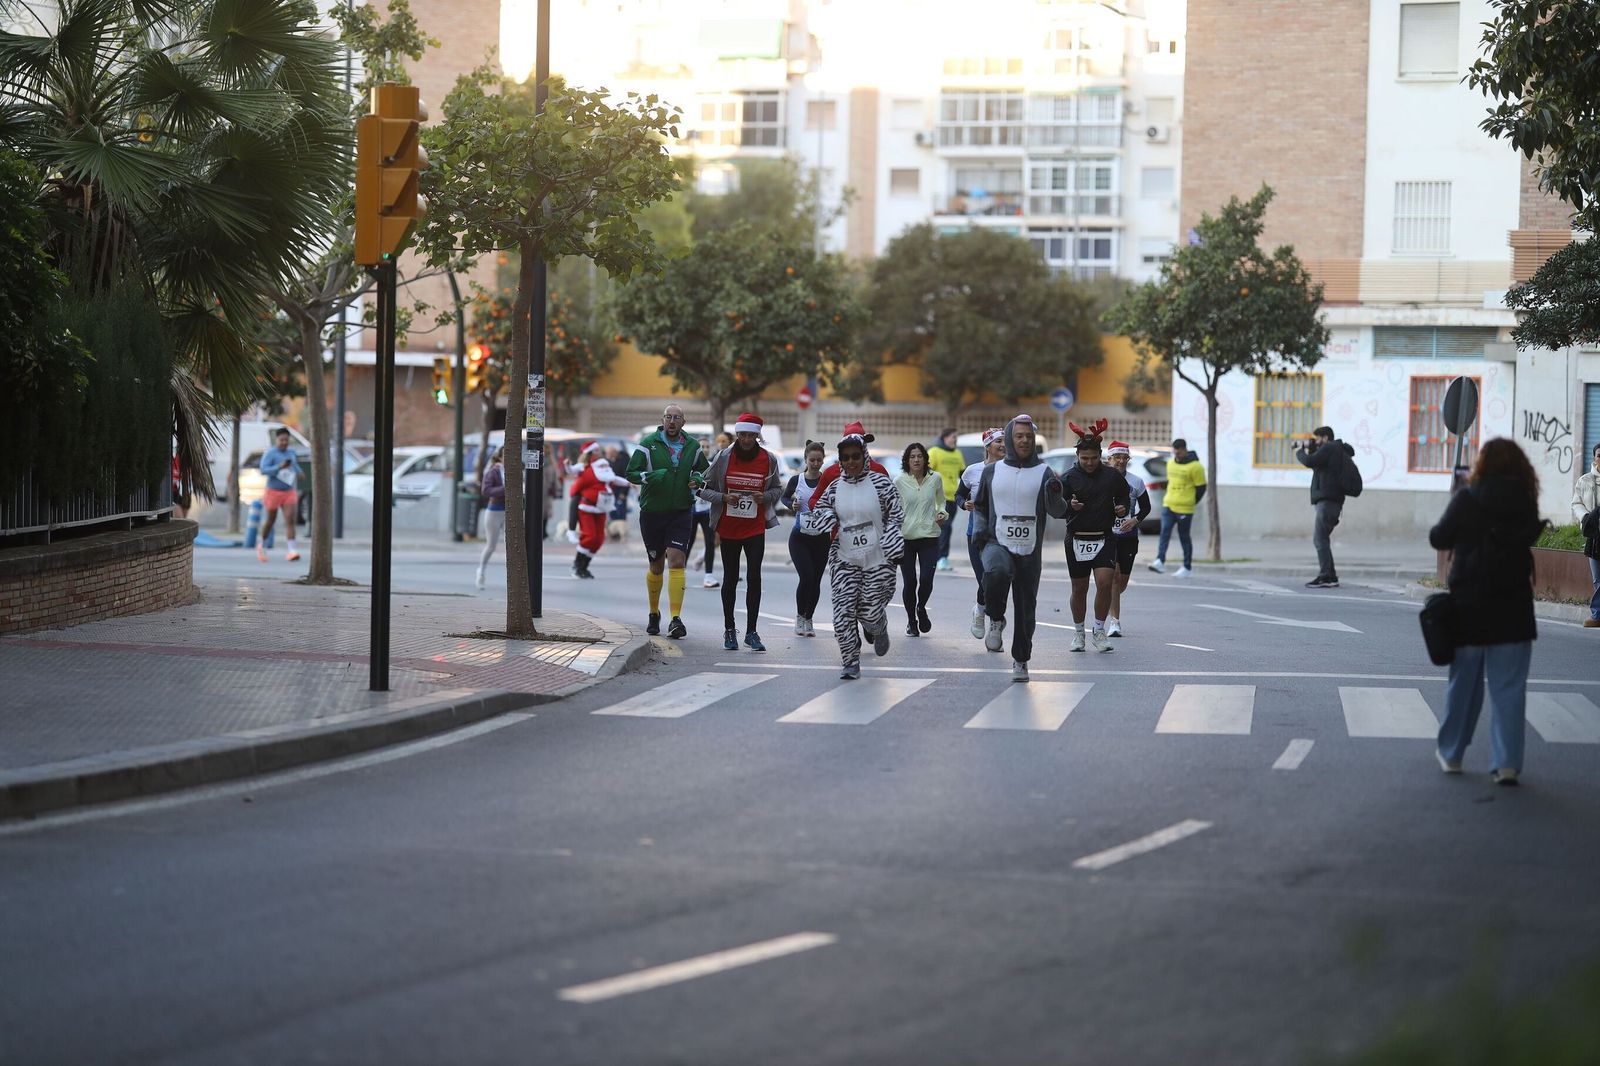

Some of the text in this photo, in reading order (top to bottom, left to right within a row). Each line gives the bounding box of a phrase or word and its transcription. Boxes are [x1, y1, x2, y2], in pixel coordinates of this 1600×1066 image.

[1006, 526, 1030, 538] 509
[852, 534, 868, 547] 46
[1079, 543, 1099, 554] 767
